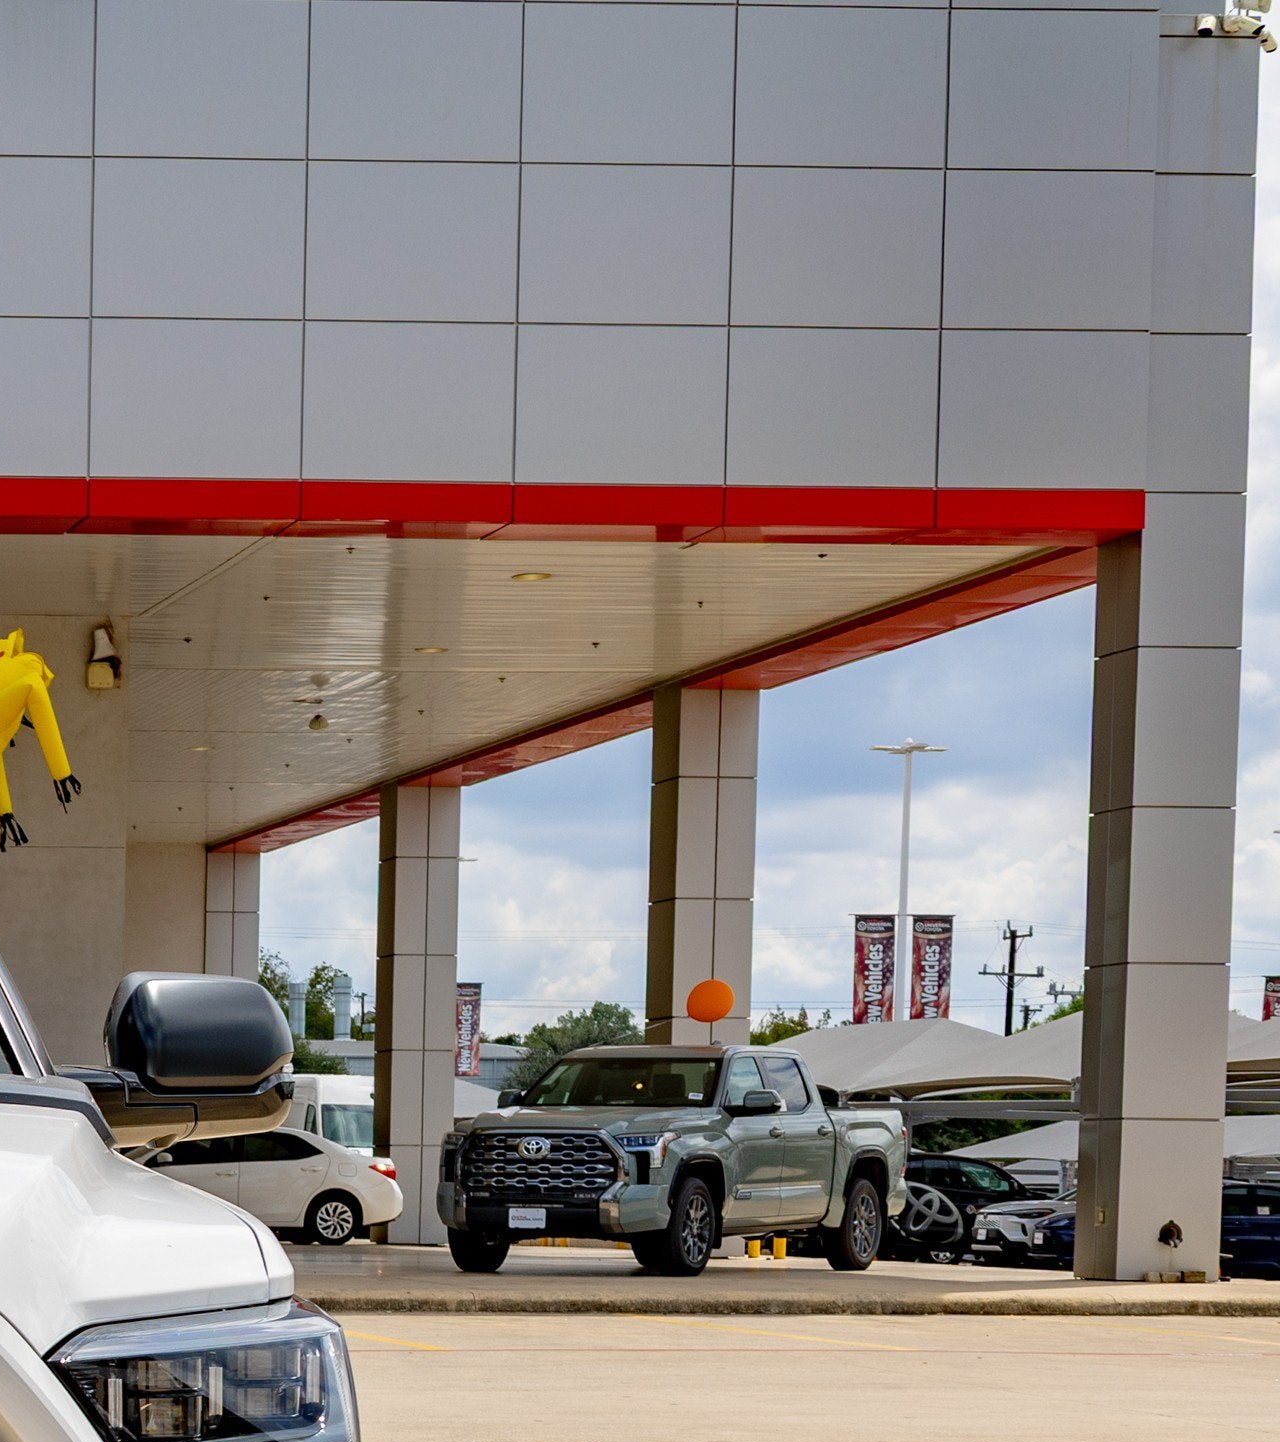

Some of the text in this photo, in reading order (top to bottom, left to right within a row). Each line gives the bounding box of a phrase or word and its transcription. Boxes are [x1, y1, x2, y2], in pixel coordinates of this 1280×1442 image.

[863, 943, 884, 1002] Vehicles
[921, 945, 940, 1003] Vehicles
[458, 1004, 473, 1047] Vehicles
[457, 1048, 471, 1072] New
